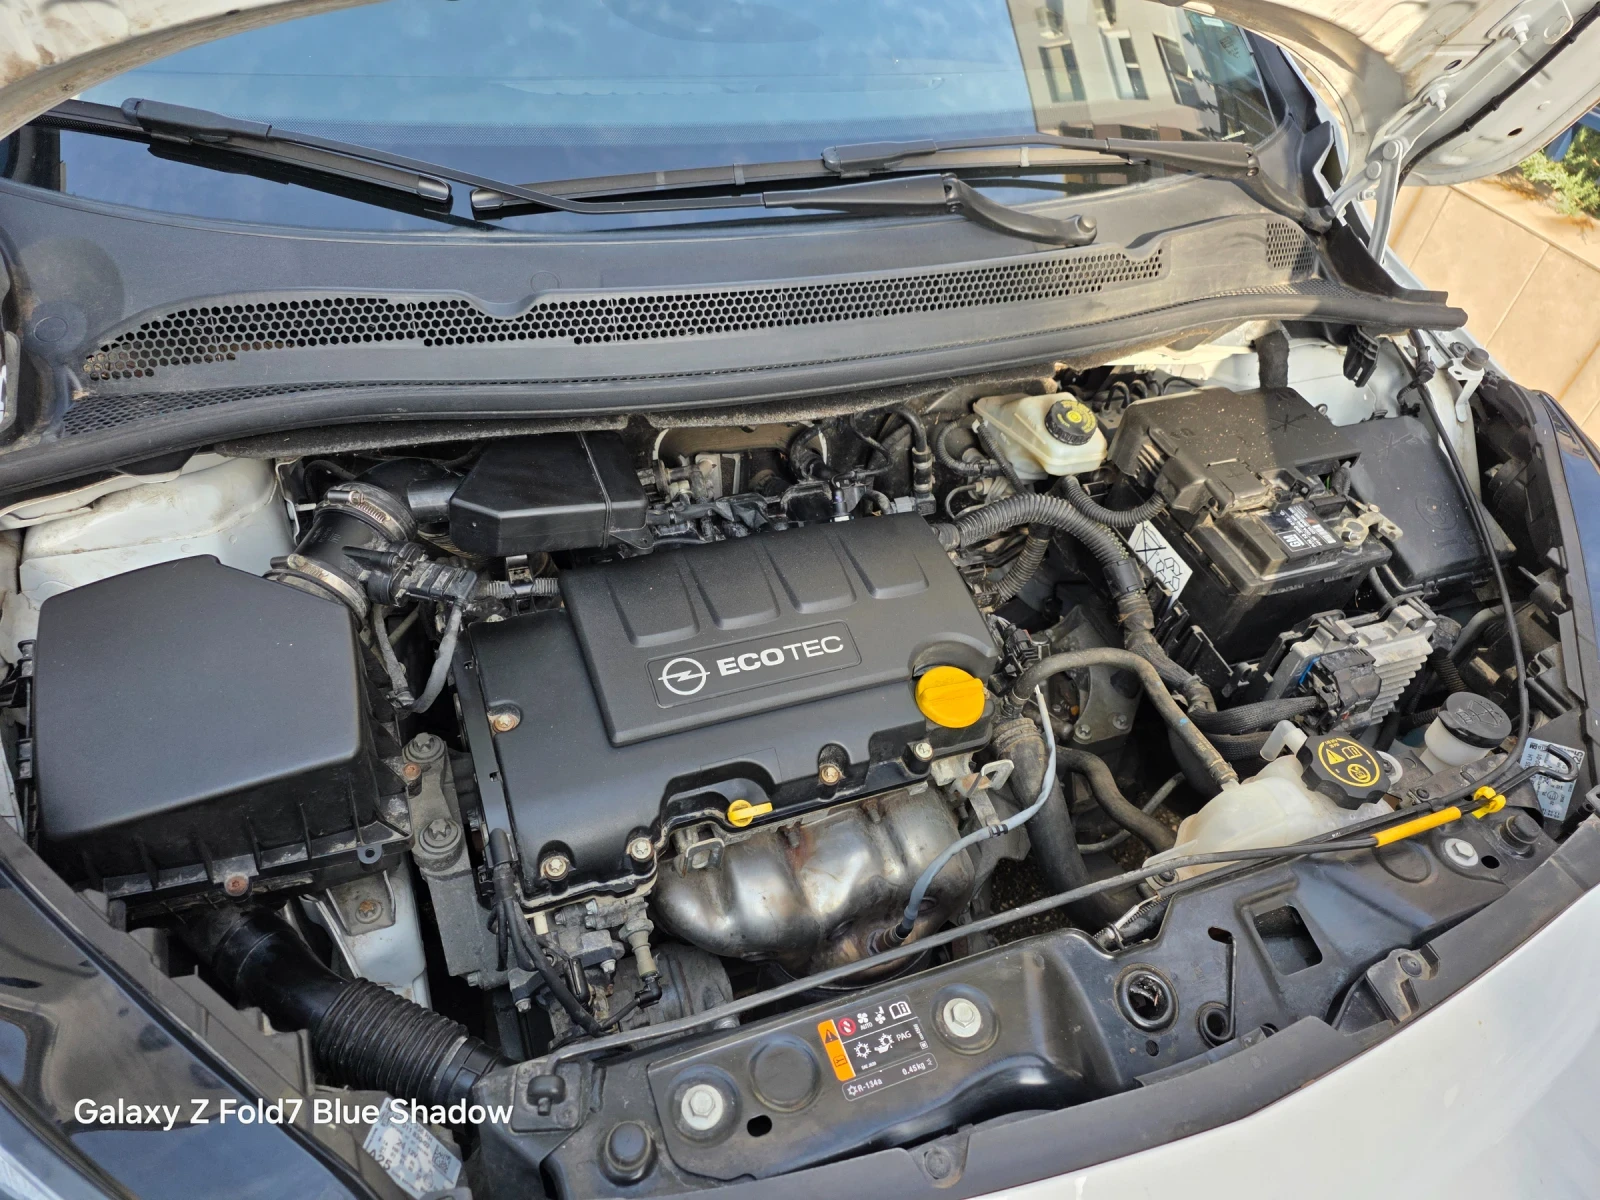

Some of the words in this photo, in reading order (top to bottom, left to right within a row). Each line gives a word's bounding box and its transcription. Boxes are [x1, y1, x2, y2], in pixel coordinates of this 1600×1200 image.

[716, 636, 844, 676] ECOTEC
[896, 1030, 912, 1042] PAG
[901, 1061, 926, 1076] 0.45kg
[857, 1078, 883, 1093] R-134a
